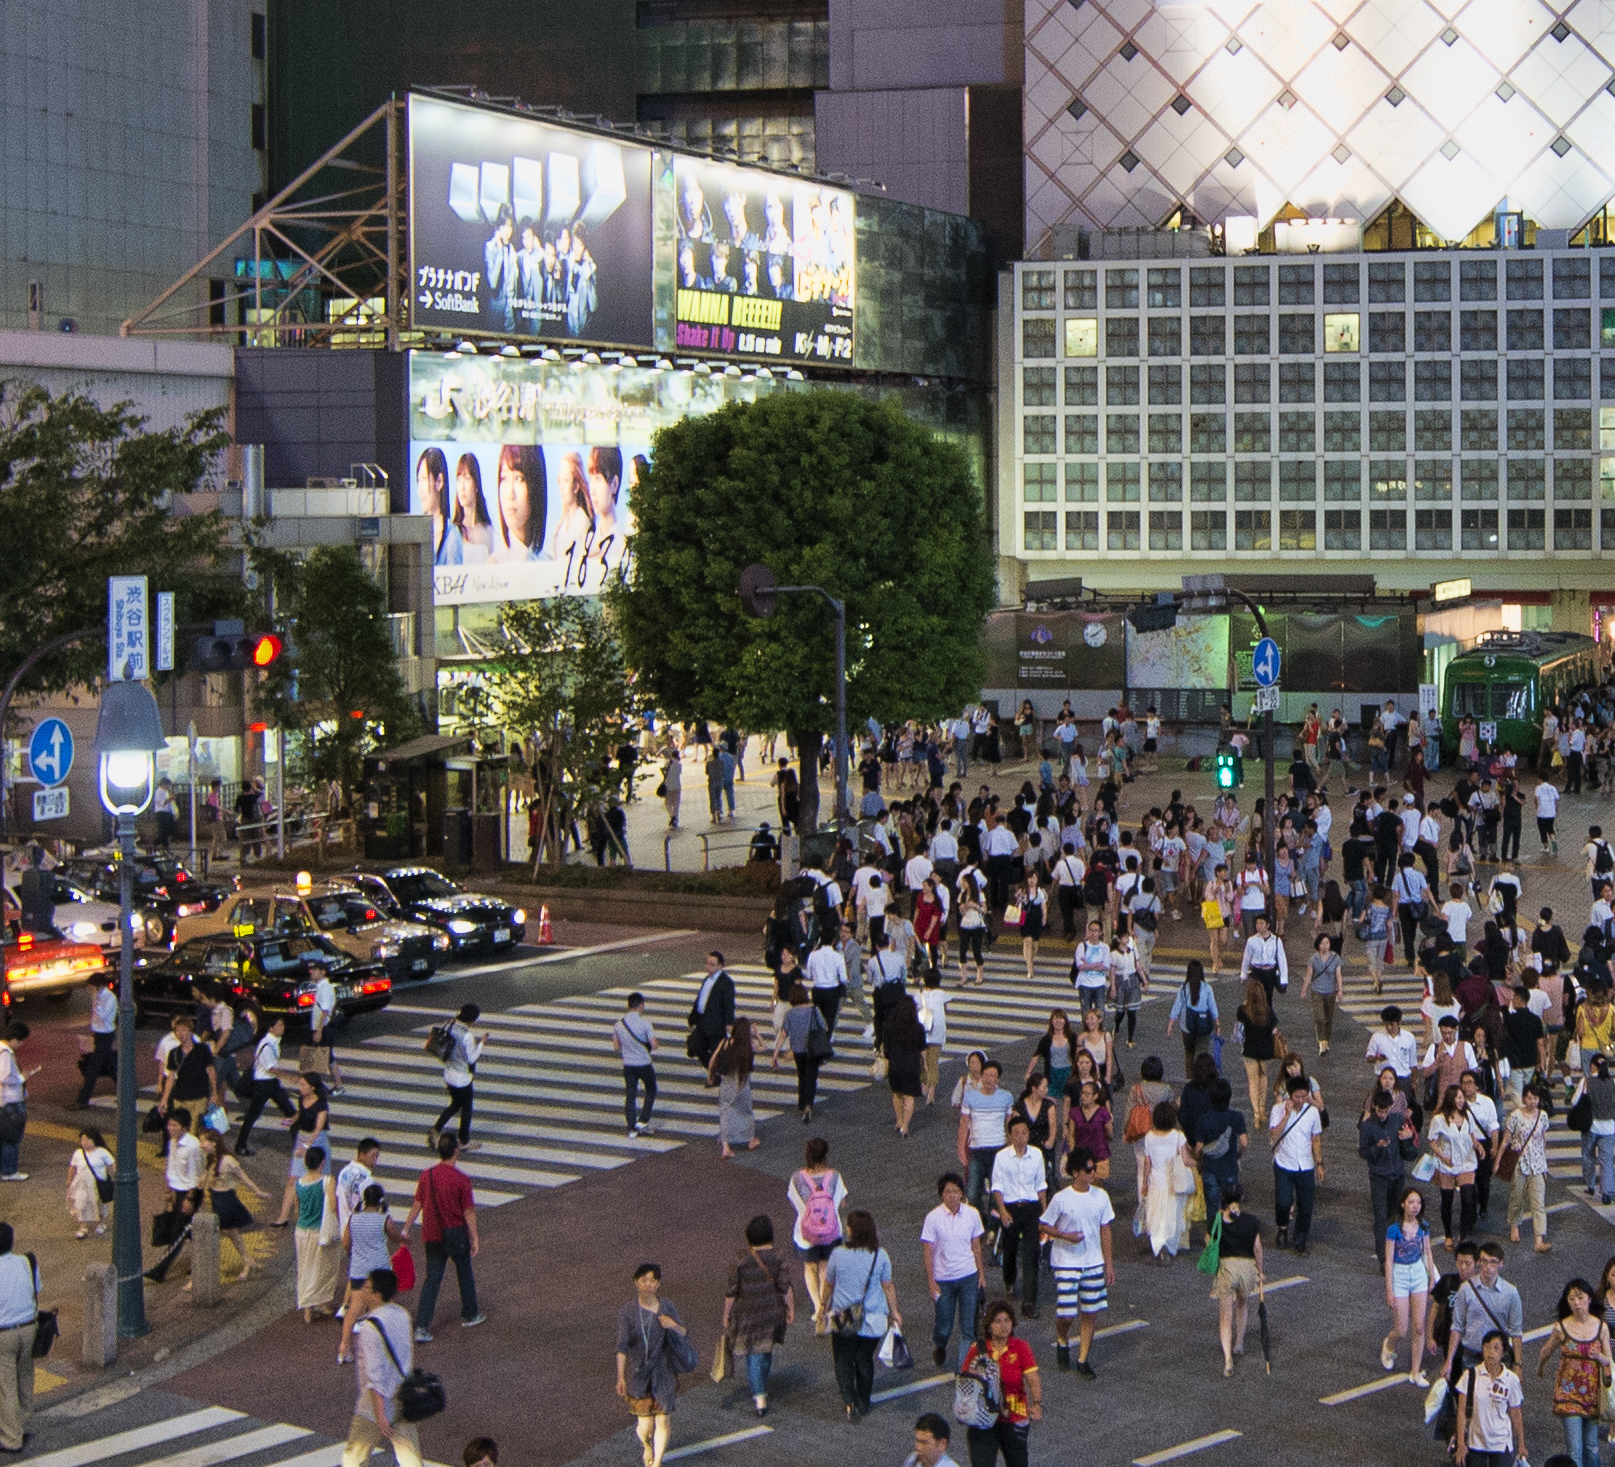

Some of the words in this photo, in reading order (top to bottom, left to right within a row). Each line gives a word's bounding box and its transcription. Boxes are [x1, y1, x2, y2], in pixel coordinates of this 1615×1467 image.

[433, 292, 480, 314] SoftBank
[677, 289, 730, 326] WANNA
[676, 322, 709, 347] Shake
[126, 585, 144, 671] 渋谷駅前
